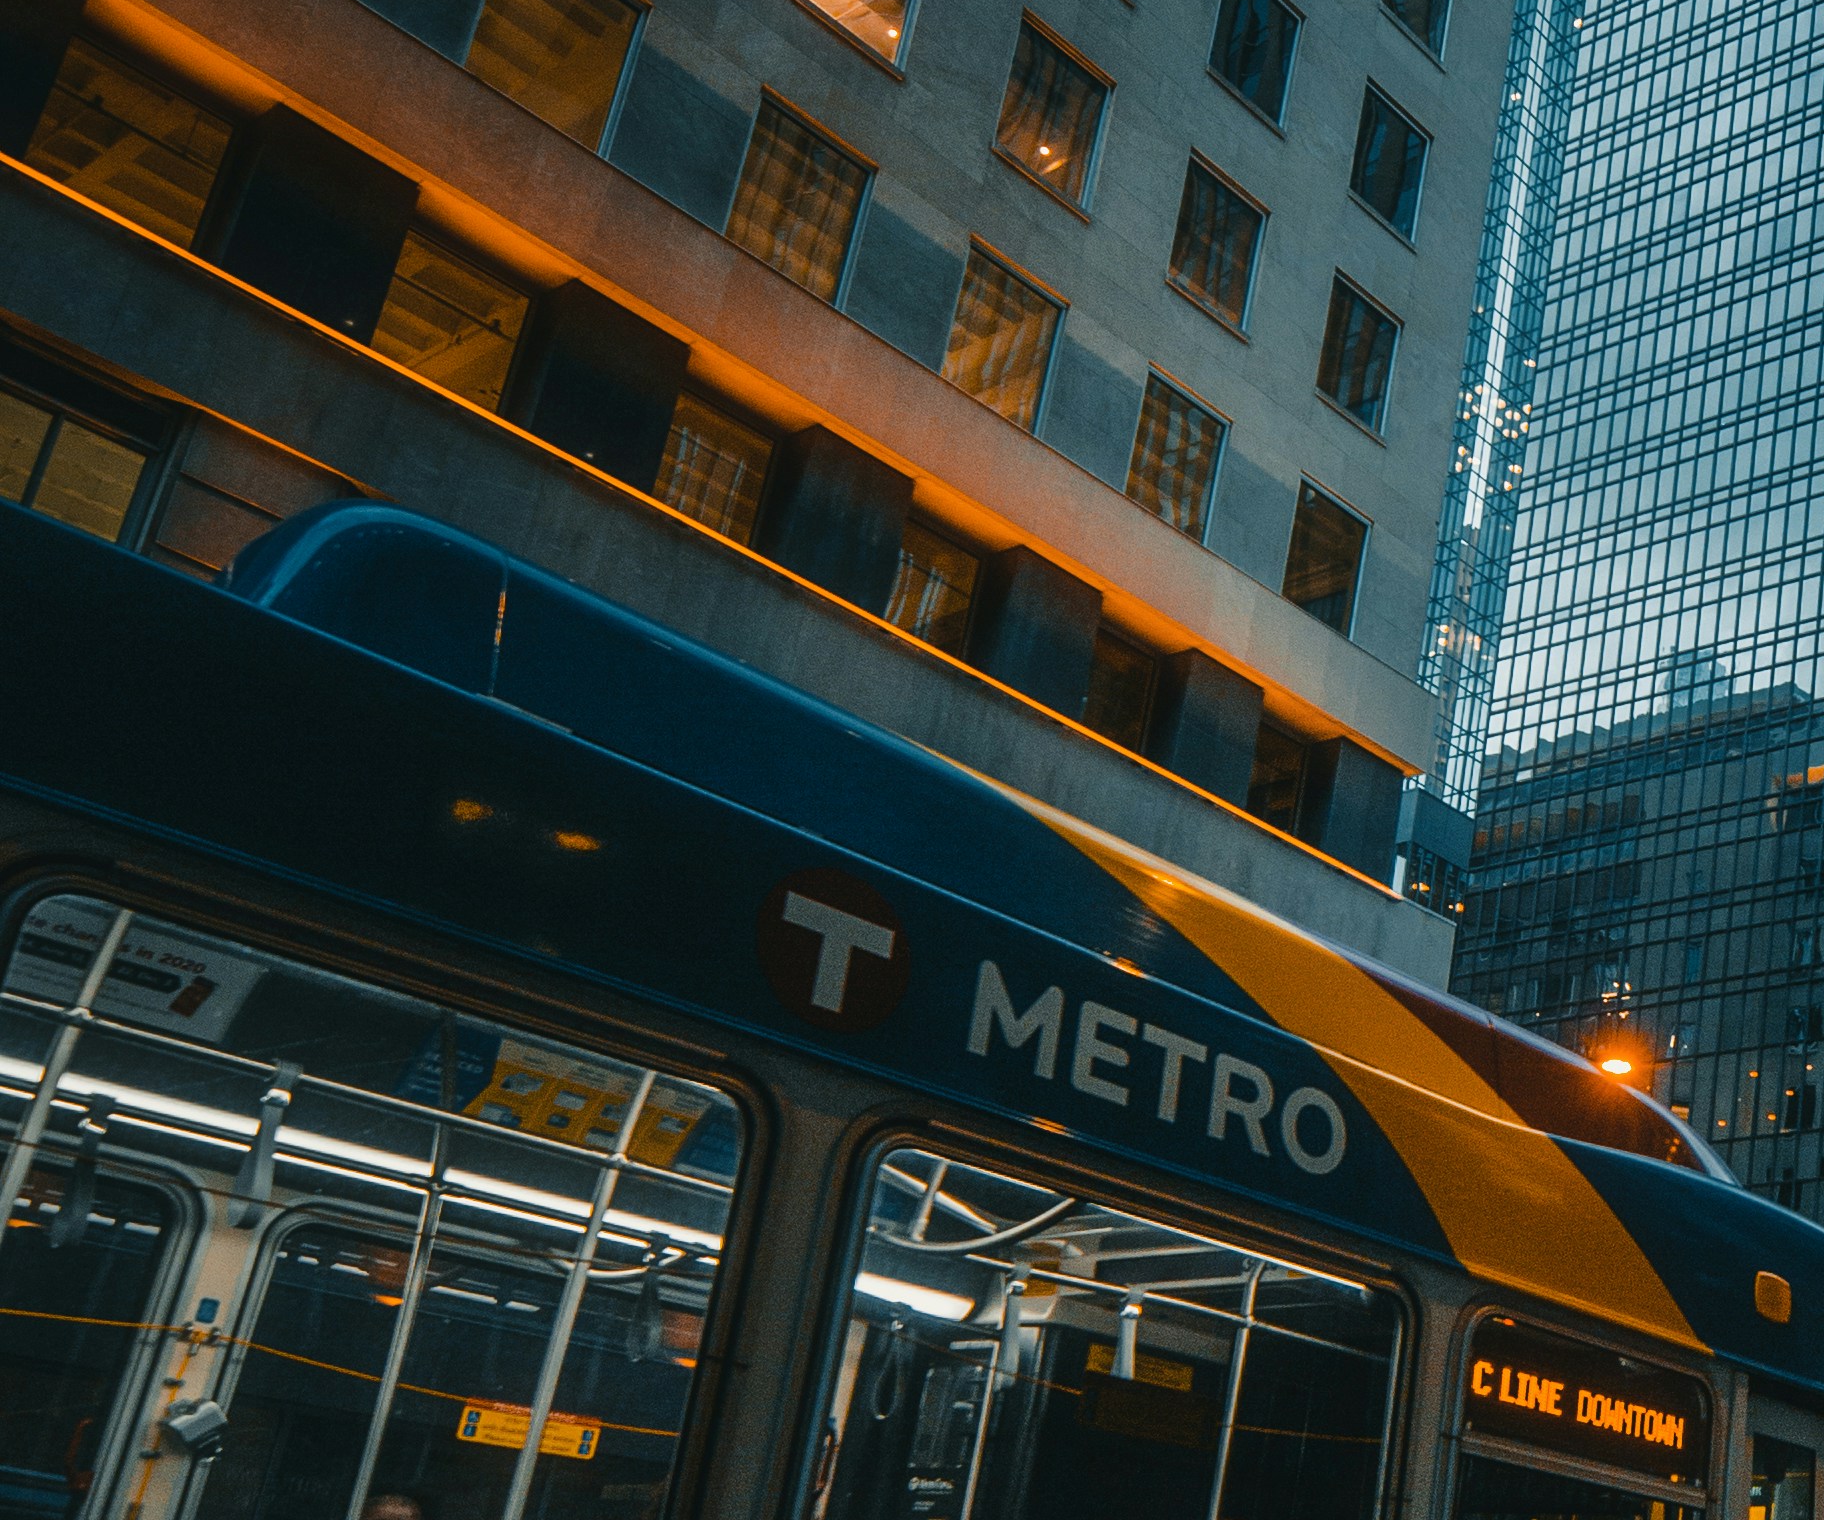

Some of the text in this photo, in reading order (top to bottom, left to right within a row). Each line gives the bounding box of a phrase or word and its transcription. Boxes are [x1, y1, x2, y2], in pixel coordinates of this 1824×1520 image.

[52, 923, 131, 953] chans
[158, 953, 207, 974] 2020
[782, 891, 896, 1013] T
[966, 960, 1349, 1176] METRO
[1471, 1360, 1685, 1450] C LINE DOWNTOWN
